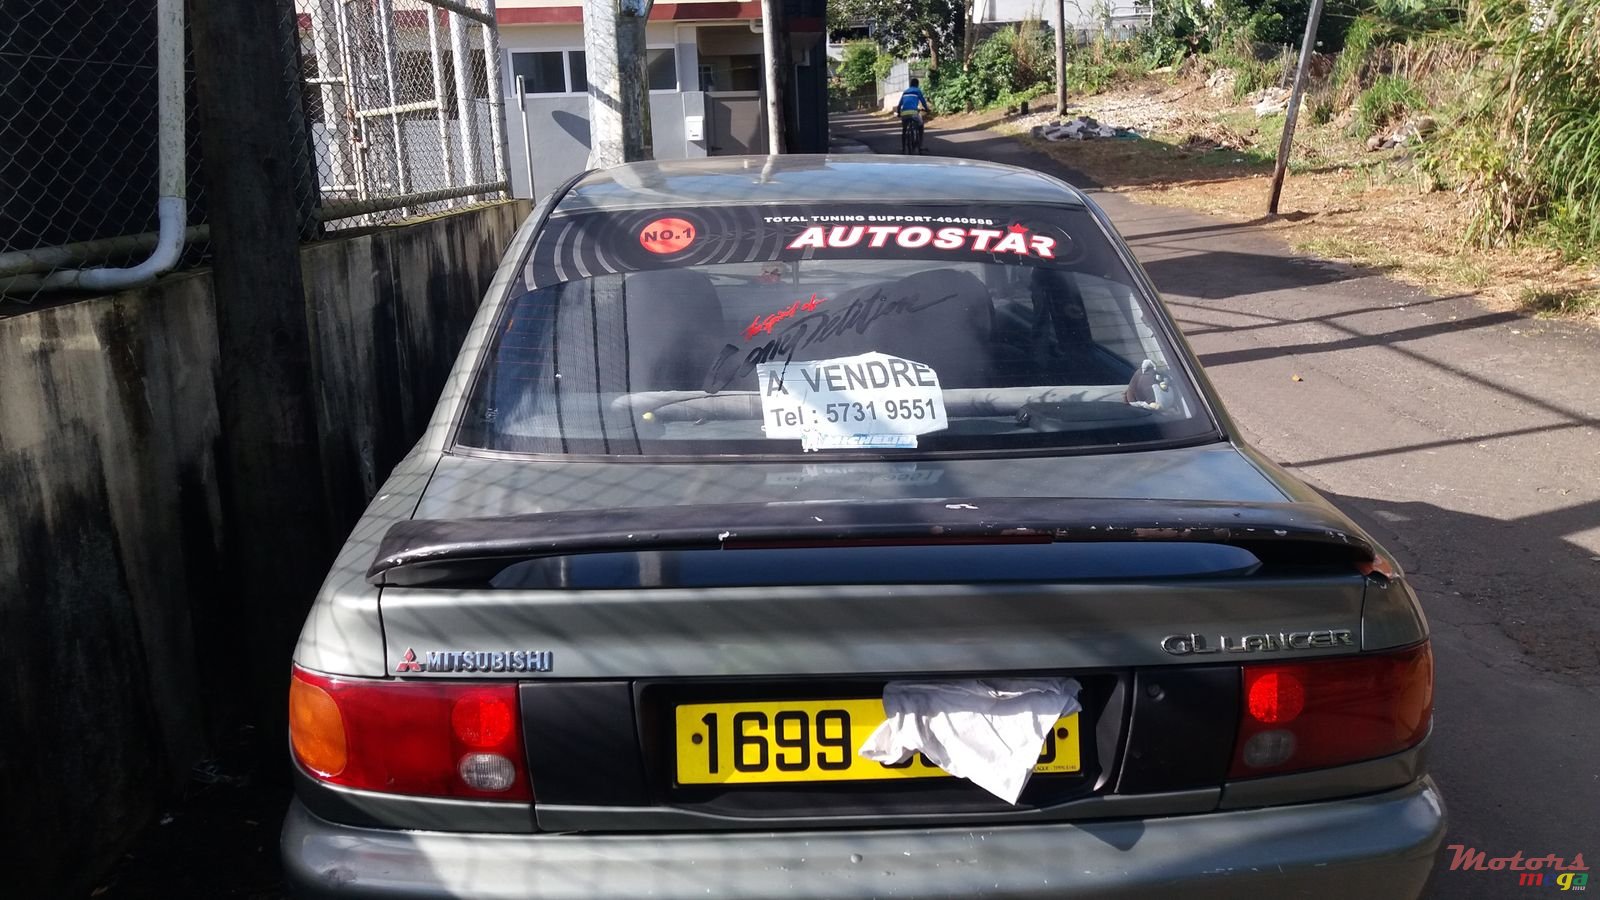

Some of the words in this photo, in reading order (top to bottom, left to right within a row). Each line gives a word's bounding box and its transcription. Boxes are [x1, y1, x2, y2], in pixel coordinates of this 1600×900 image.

[763, 215, 809, 223] TOTAL
[644, 227, 692, 243] NO.1
[785, 225, 1057, 258] AUTOSTAR
[766, 369, 789, 397] A
[800, 358, 936, 394] VENDRE
[770, 405, 804, 428] Tel
[826, 401, 877, 423] 5731
[885, 398, 937, 420] 9551
[1160, 633, 1217, 656] GL
[1220, 629, 1354, 652] LANCER
[425, 650, 553, 672] MITSUBISHI
[701, 709, 852, 774] 1699
